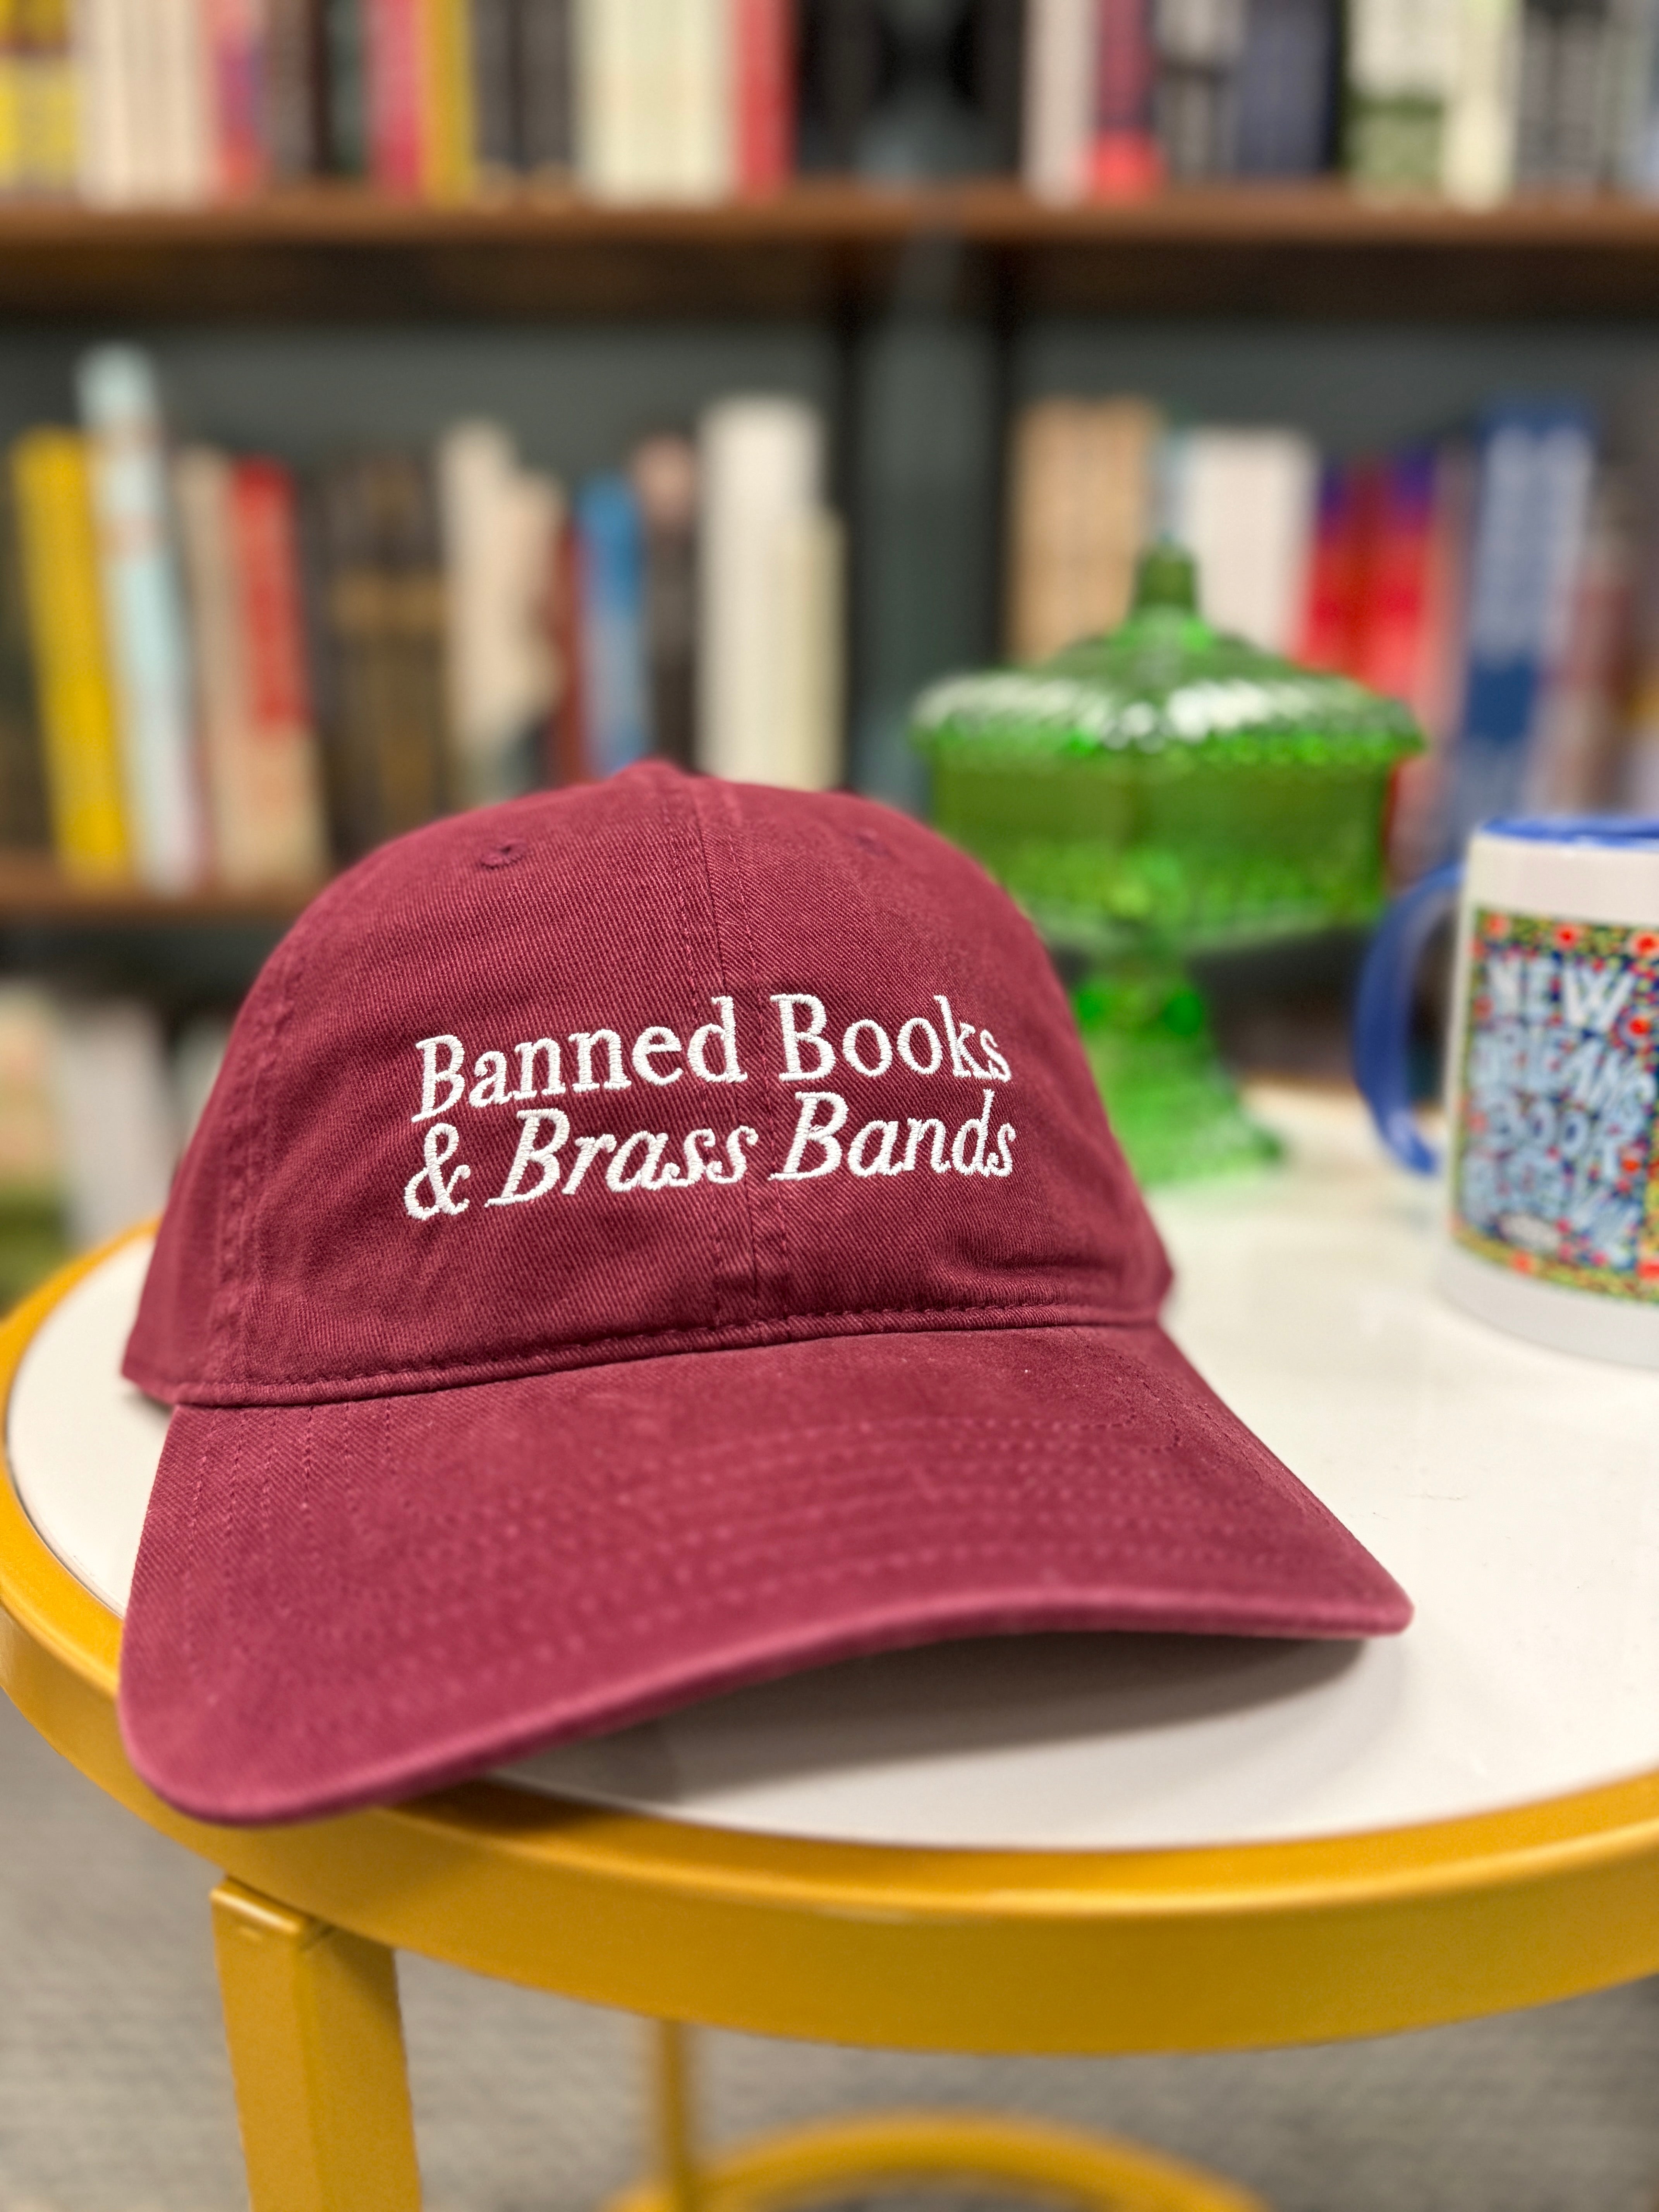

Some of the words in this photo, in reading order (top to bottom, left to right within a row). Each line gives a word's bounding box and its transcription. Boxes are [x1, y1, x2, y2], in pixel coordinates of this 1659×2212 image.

[410, 994, 749, 1124] Banned
[769, 993, 1013, 1084] Books
[403, 1121, 472, 1222] &
[483, 1107, 759, 1208] Brass
[767, 1088, 1017, 1182] Bands
